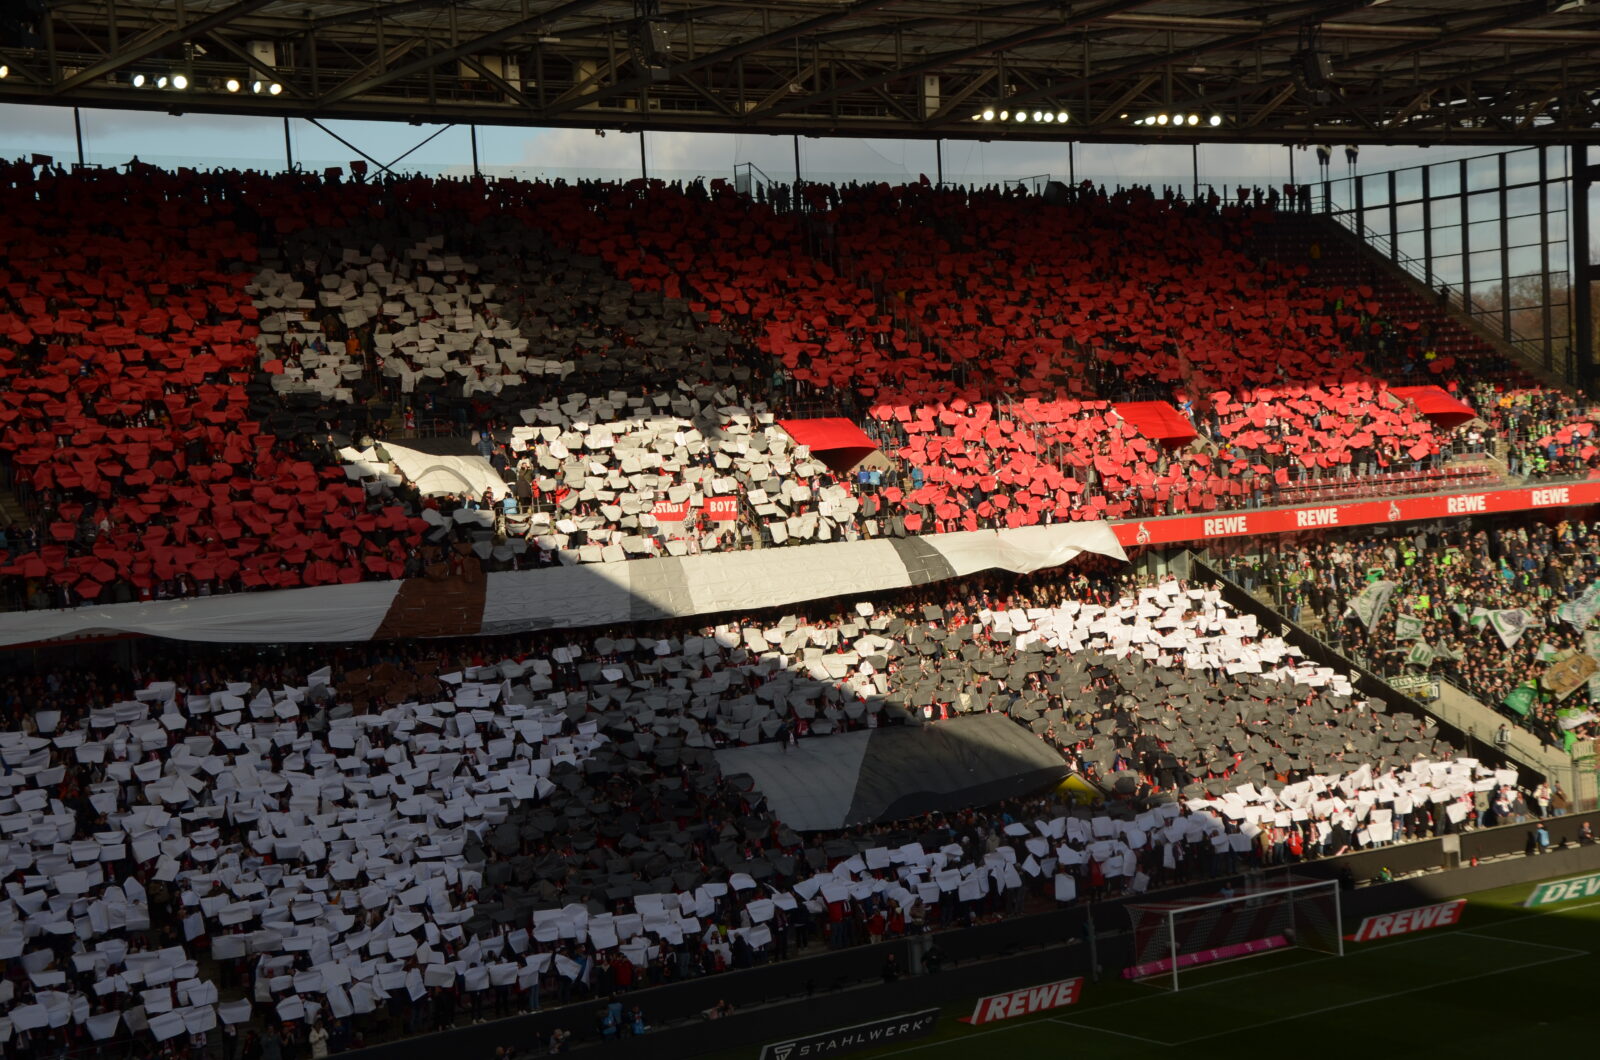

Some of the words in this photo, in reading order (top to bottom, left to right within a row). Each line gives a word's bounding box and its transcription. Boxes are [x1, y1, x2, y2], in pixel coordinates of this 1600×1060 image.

[1447, 495, 1486, 513] REWE
[1532, 488, 1569, 505] REWE
[710, 500, 737, 512] BOYZ
[1204, 516, 1247, 535] REWE
[1297, 508, 1338, 526] REWE
[1367, 903, 1460, 940] REWE
[984, 980, 1076, 1022] REWE
[799, 1019, 925, 1056] STAHLWERK
